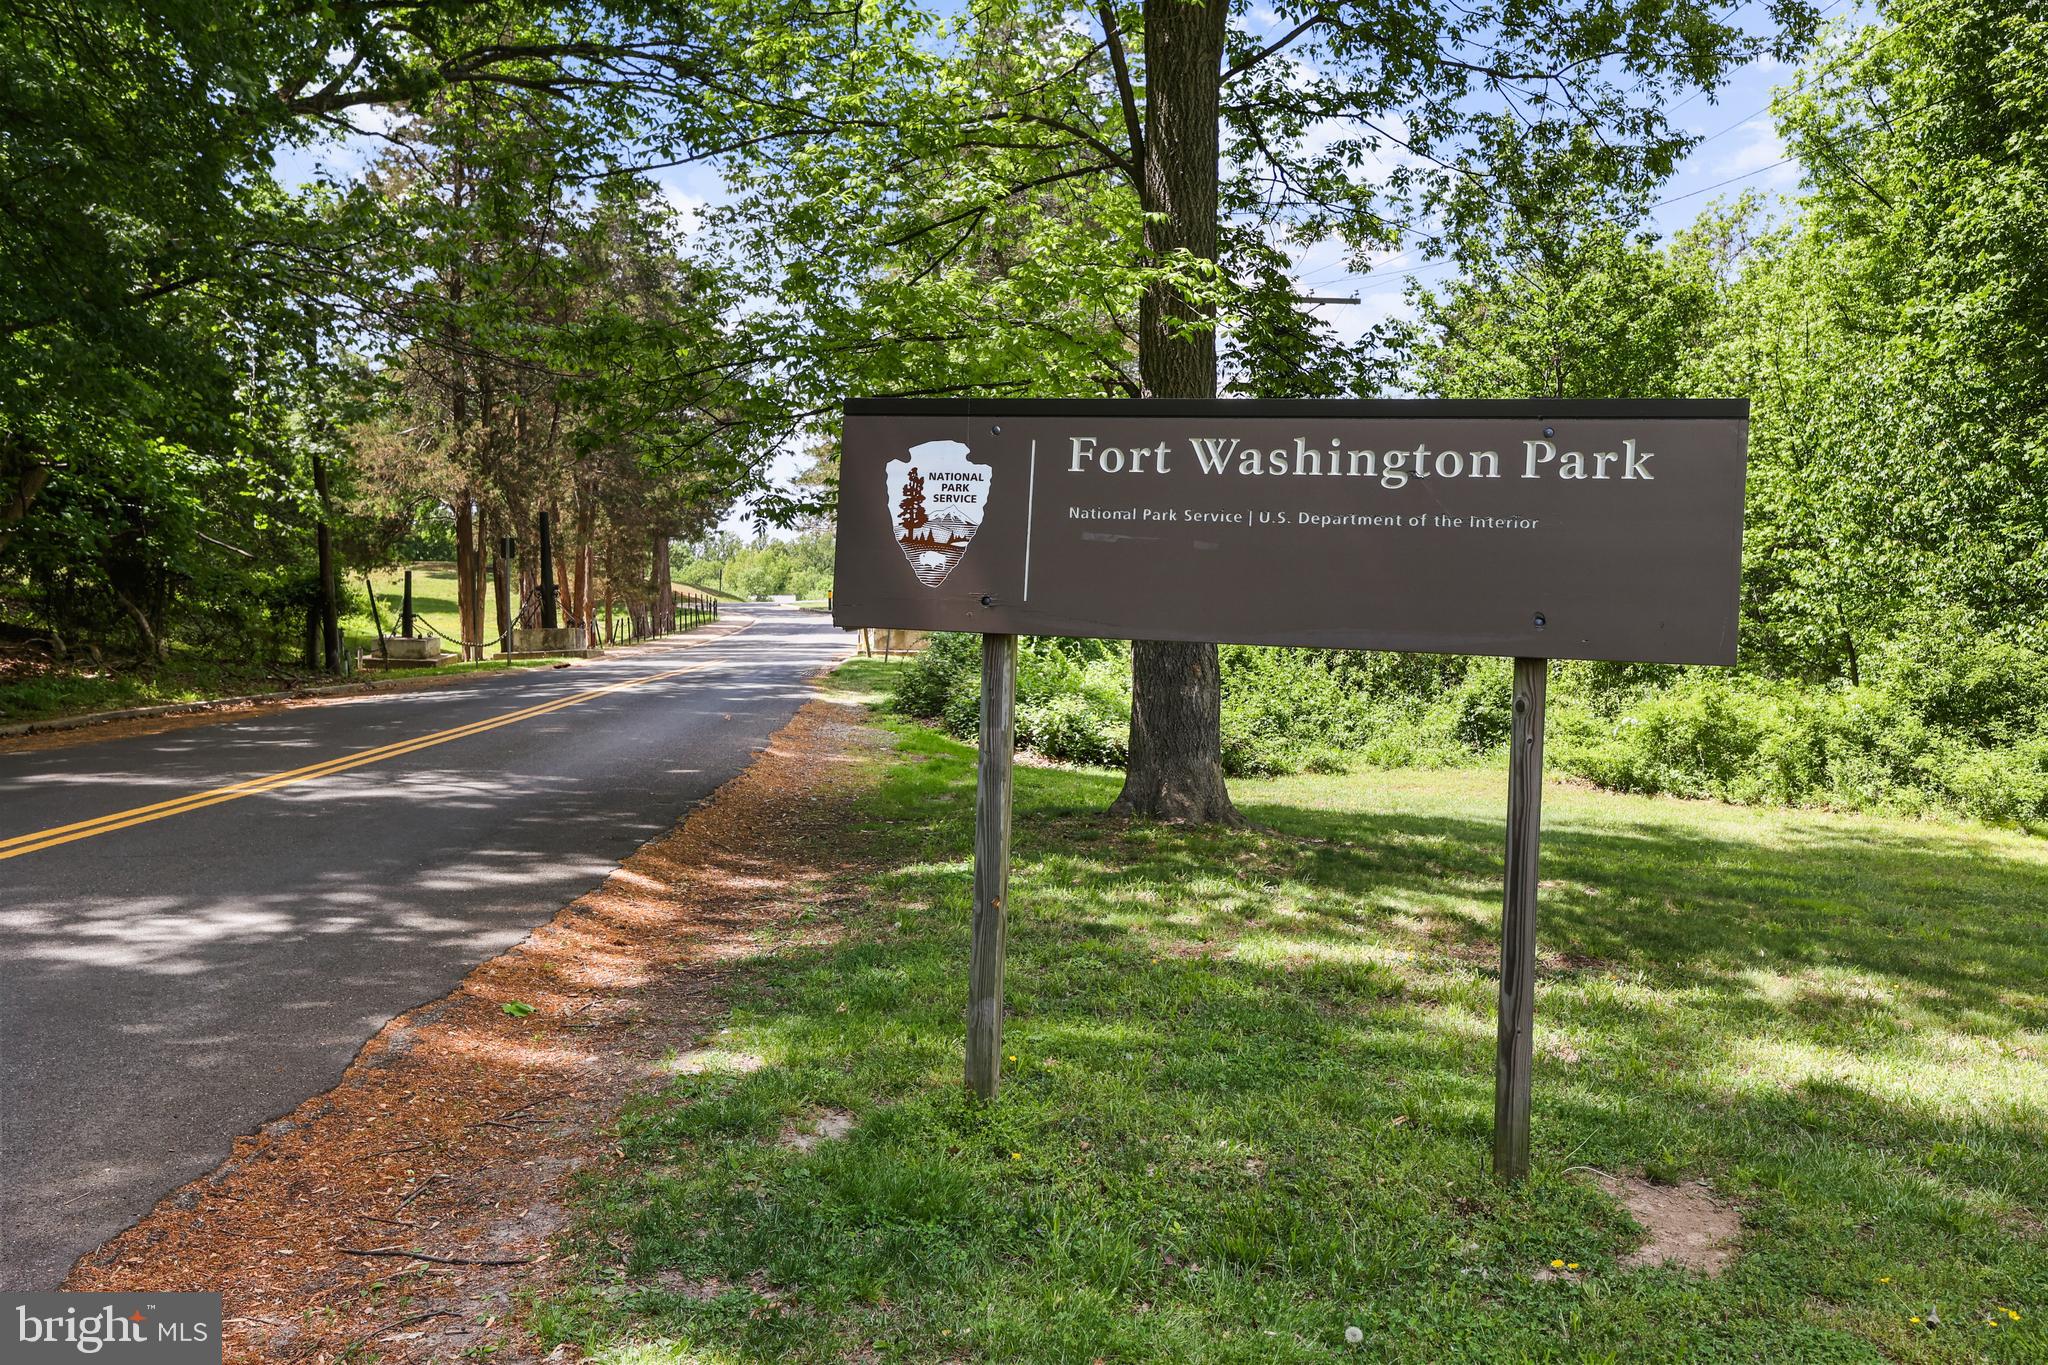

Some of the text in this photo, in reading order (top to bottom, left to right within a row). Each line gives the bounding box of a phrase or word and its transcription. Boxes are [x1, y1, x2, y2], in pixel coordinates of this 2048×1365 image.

[1067, 436, 1656, 490] Fort Washington Park
[928, 472, 984, 482] NATIONAL
[941, 483, 970, 493] PARK
[933, 494, 977, 504] SERVICE
[1069, 506, 1540, 530] National Park Service U.S. Department of the Interior
